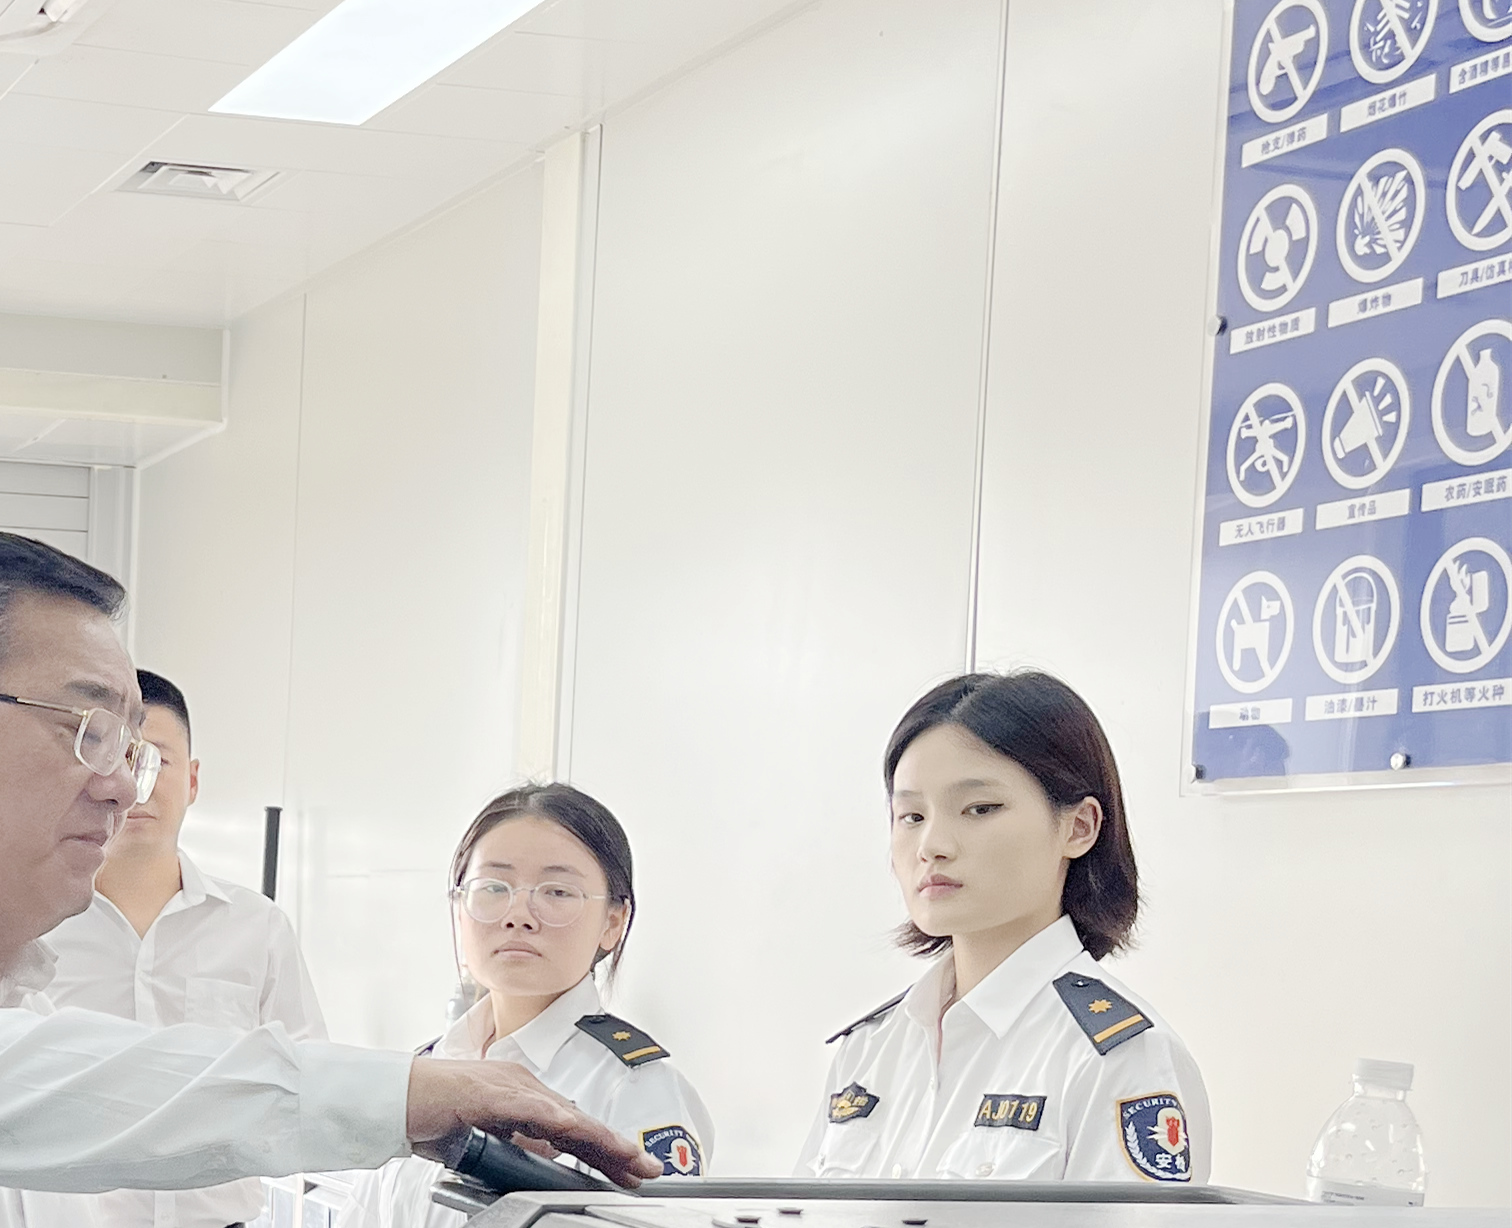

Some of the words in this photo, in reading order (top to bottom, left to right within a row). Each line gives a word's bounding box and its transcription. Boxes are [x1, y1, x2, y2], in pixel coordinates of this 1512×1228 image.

[1458, 259, 1512, 288] 刀具/仿真
[1357, 293, 1392, 315] 爆炸物
[1244, 315, 1301, 345] 放射性物质
[1444, 475, 1508, 502] 农药/安眠药
[1346, 500, 1377, 520] 宣传品
[1234, 516, 1286, 539] 无人飞行器
[1324, 696, 1378, 715] 油漆/墨汁
[1422, 684, 1506, 707] 打火机等火种
[1123, 1098, 1178, 1119] SECURITY
[644, 1129, 684, 1148] SECURITY
